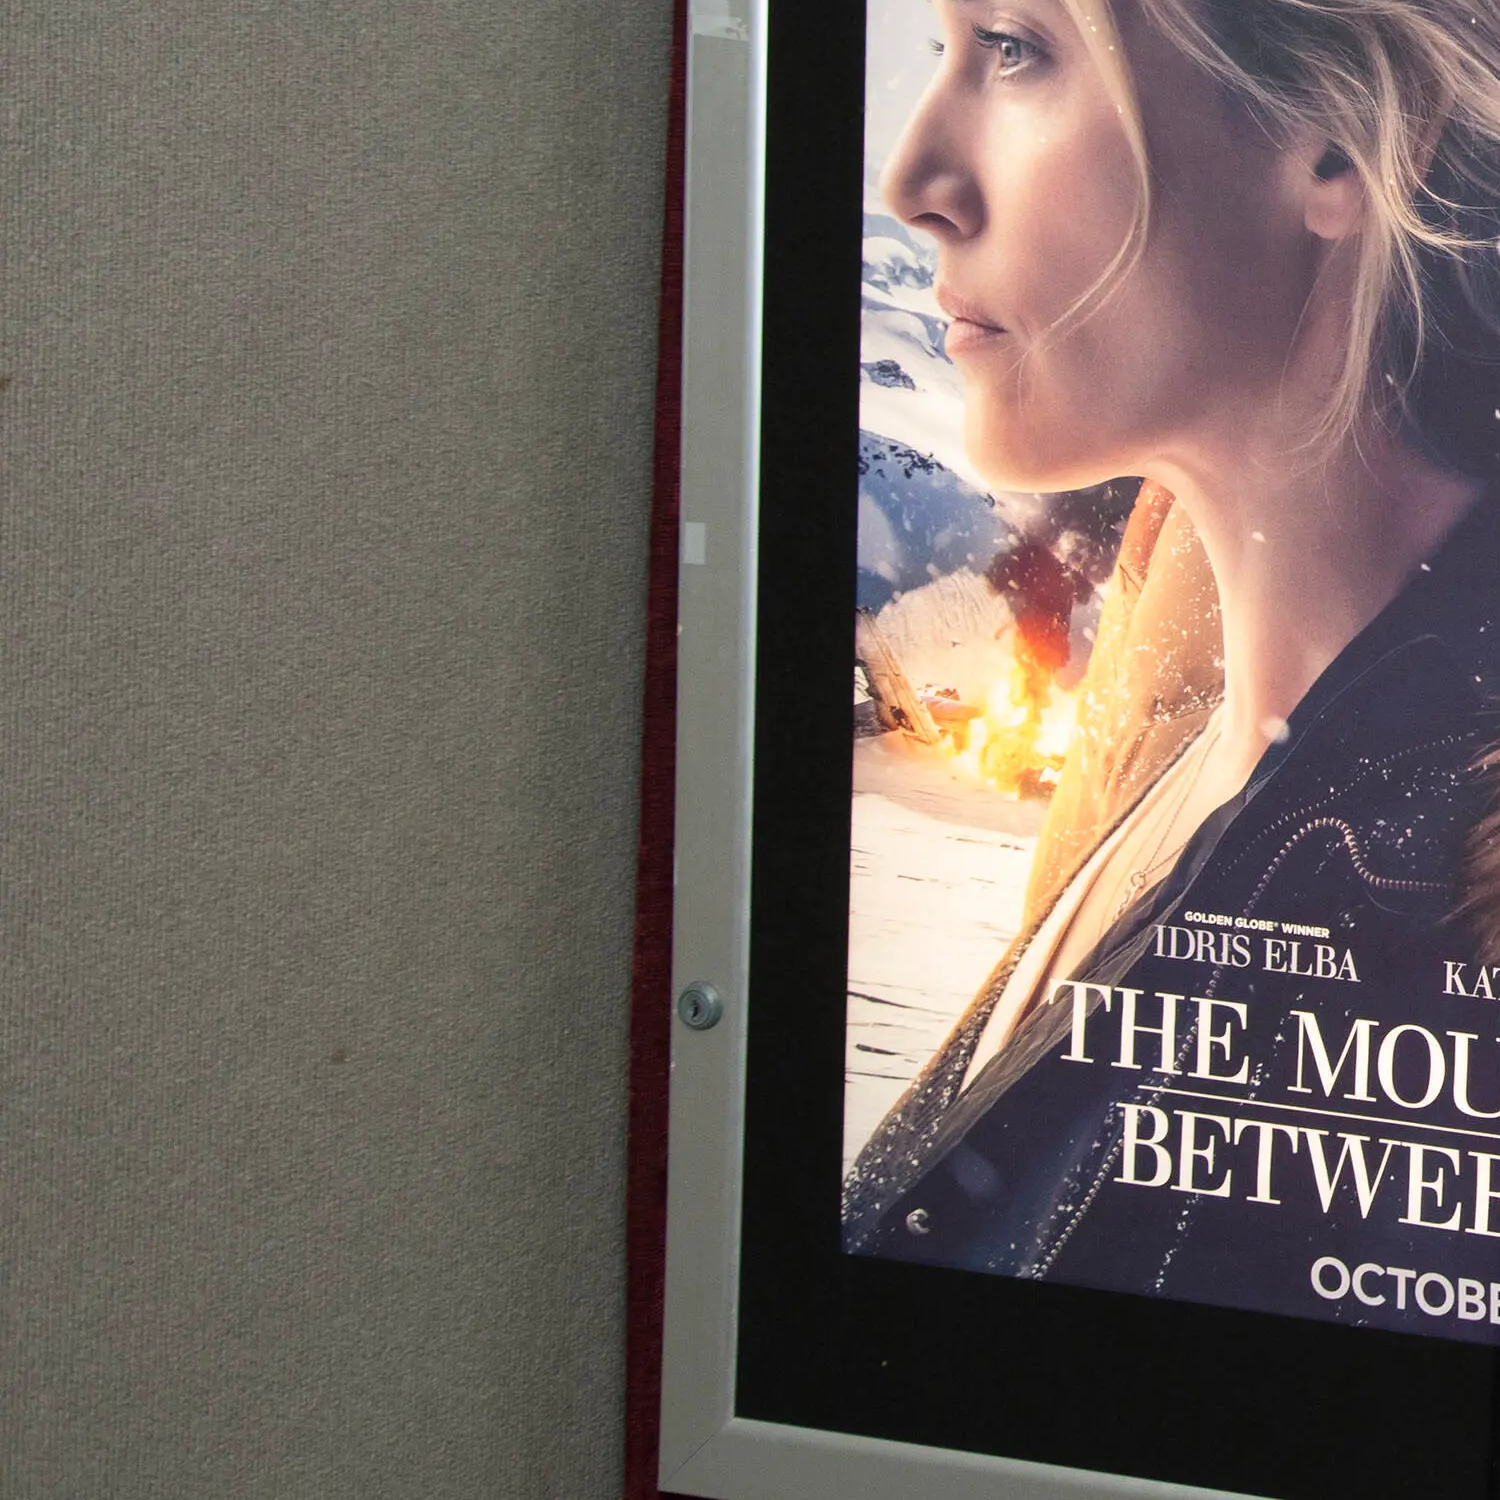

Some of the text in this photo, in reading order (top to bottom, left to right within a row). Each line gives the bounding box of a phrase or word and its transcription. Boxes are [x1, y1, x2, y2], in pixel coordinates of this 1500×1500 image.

[1153, 924, 1361, 983] IDRIS ELBA
[1184, 911, 1233, 927] GOLDEN
[1282, 923, 1330, 939] WINNER
[1049, 979, 1250, 1085] THE
